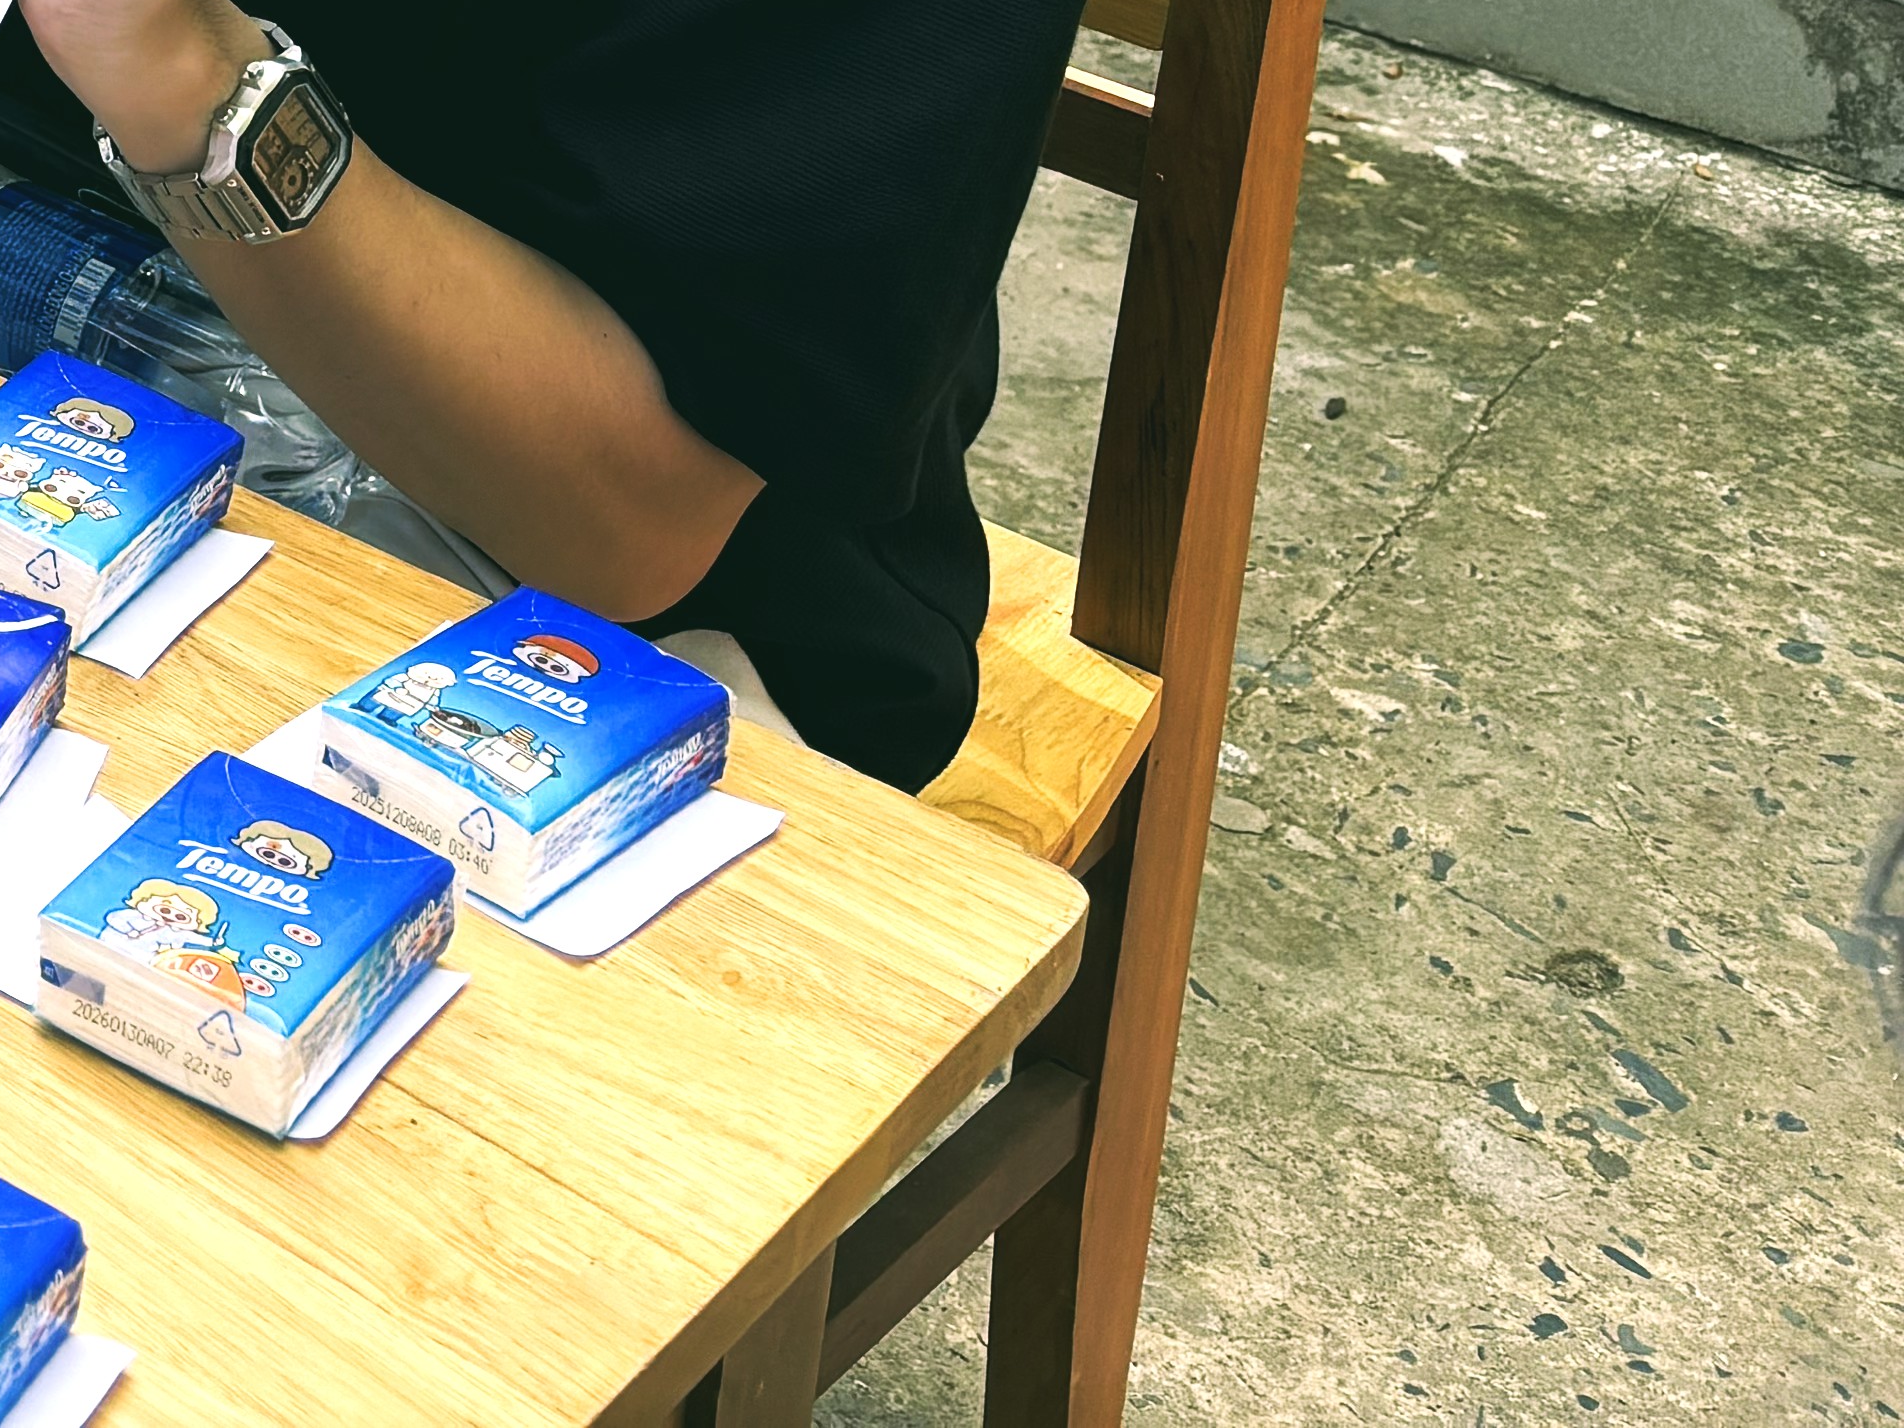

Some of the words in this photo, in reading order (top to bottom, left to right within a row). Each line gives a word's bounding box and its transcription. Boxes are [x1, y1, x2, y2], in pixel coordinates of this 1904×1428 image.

[15, 414, 127, 464] Tempo
[463, 651, 588, 716] Tempo
[177, 840, 309, 905] Tempo
[72, 999, 176, 1059] 20260130A07
[182, 1052, 233, 1088] 22:38
